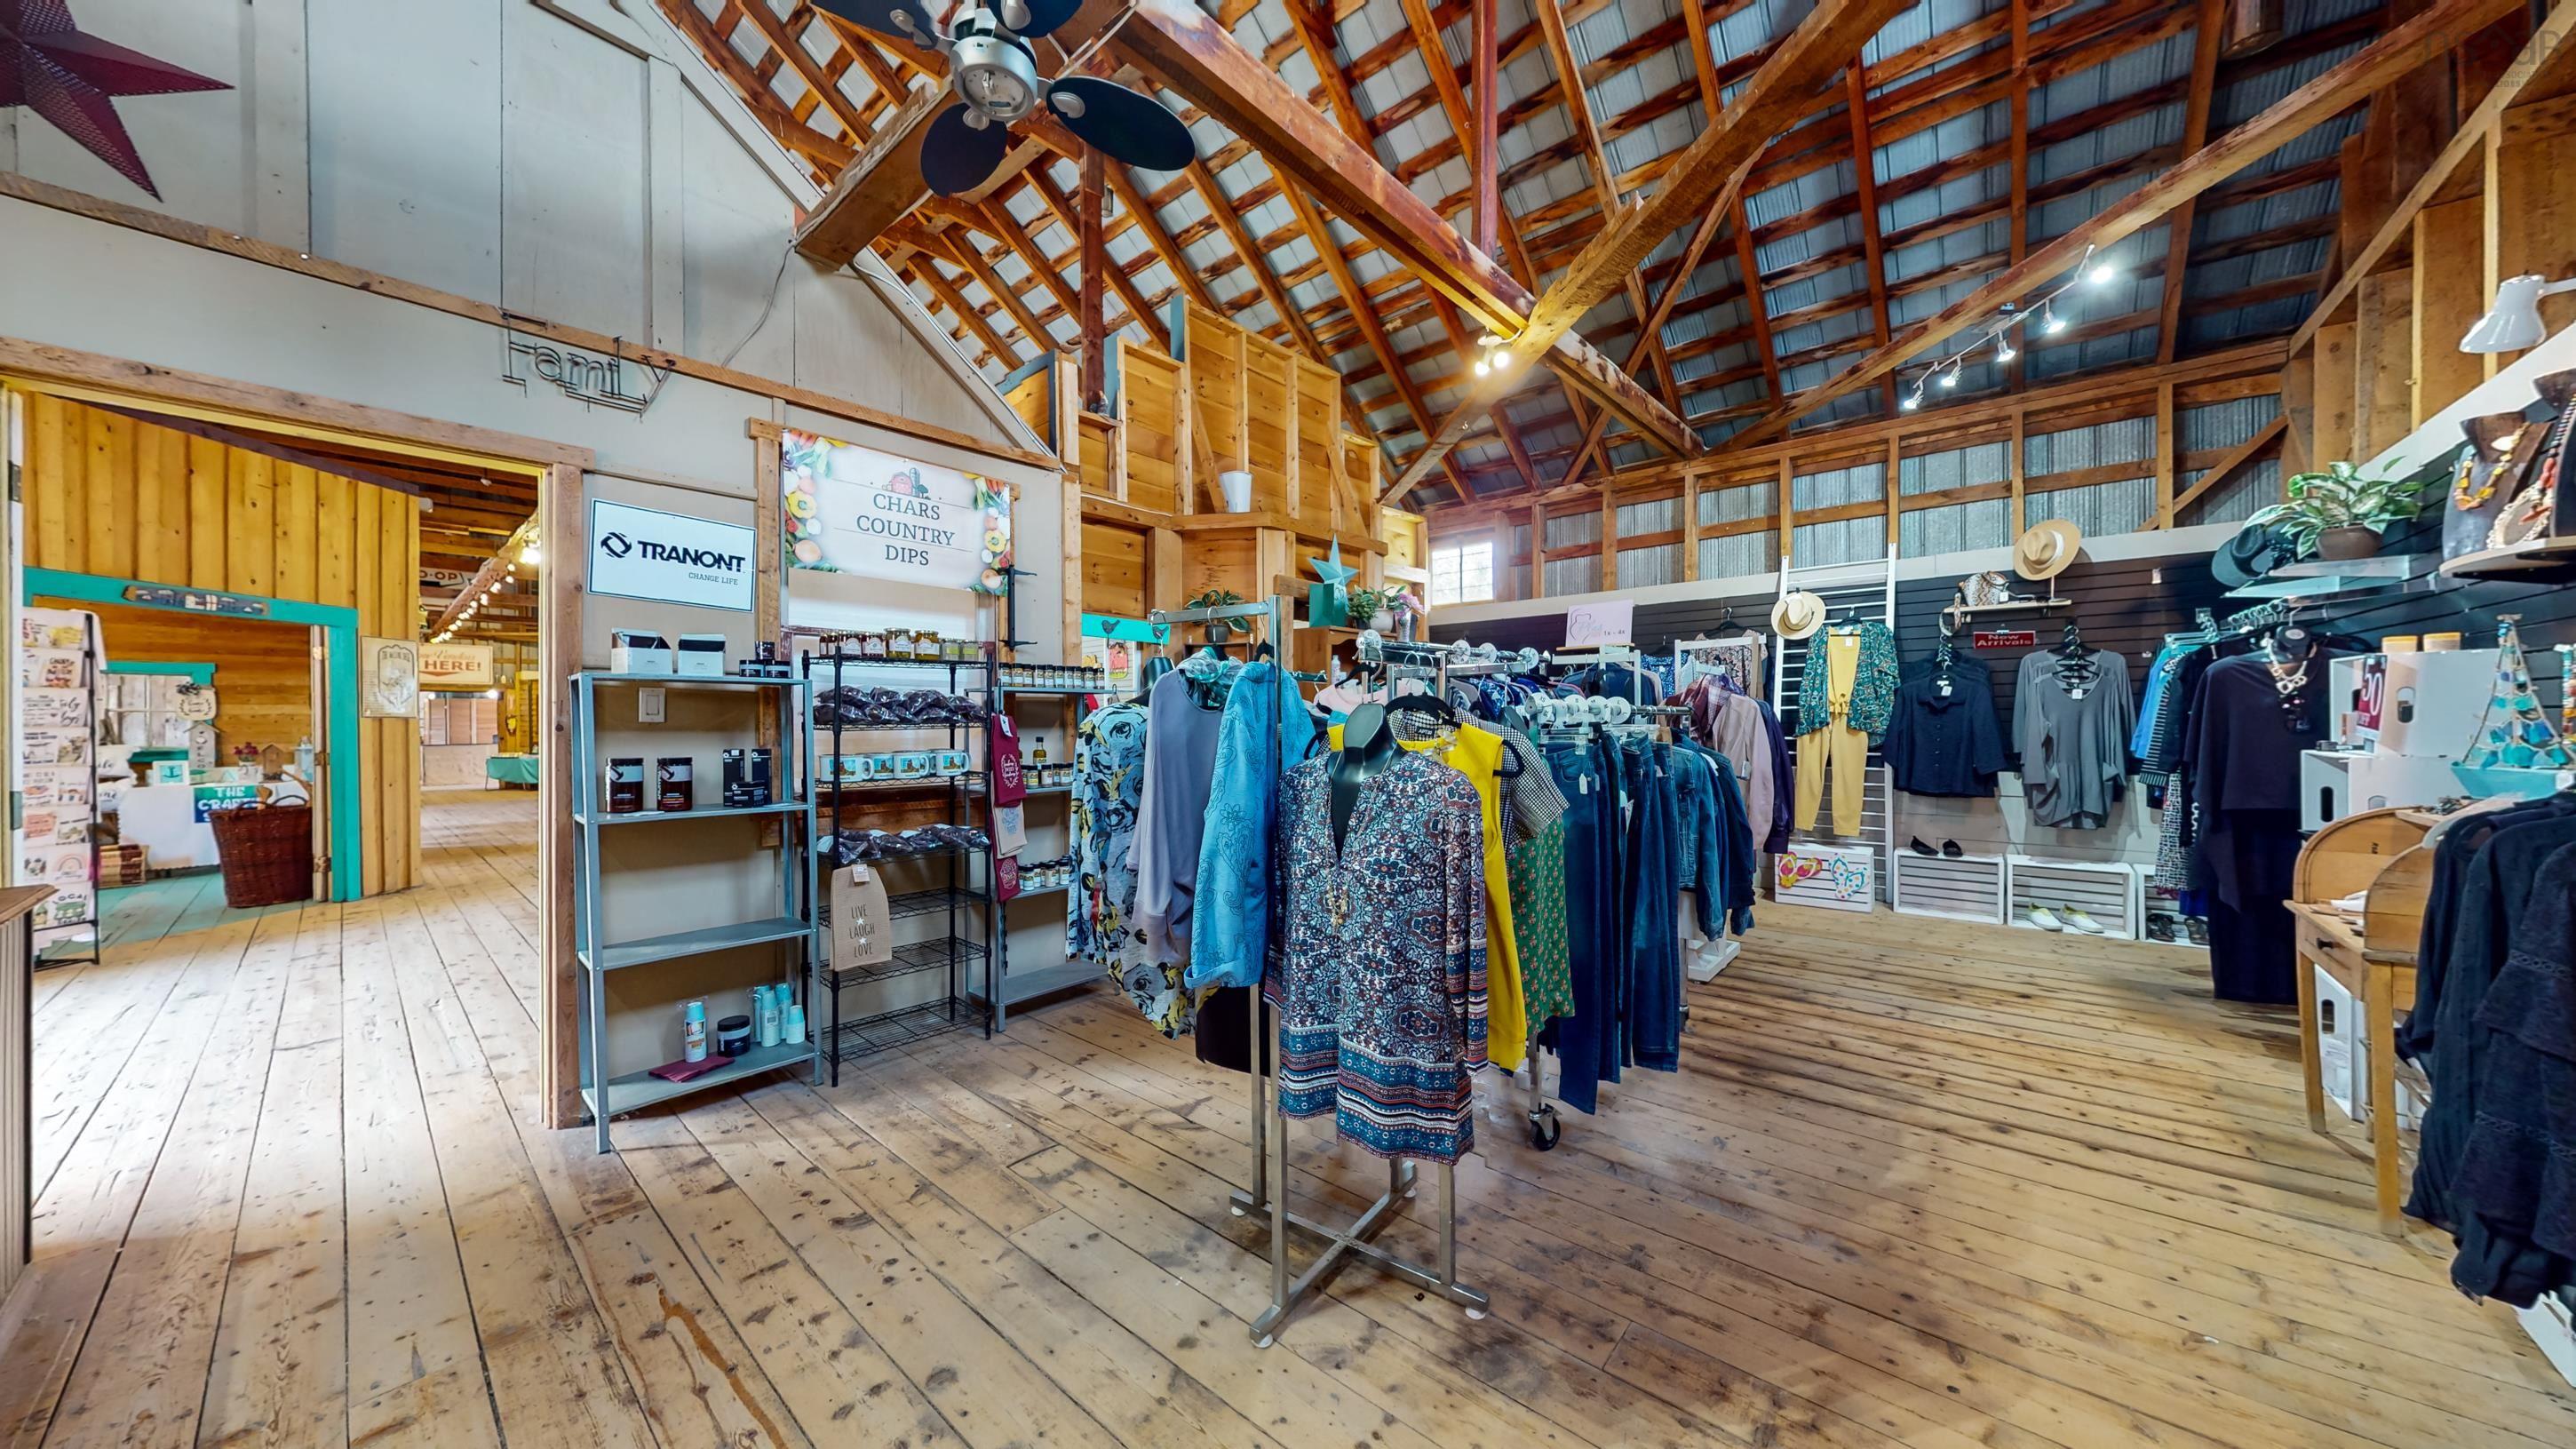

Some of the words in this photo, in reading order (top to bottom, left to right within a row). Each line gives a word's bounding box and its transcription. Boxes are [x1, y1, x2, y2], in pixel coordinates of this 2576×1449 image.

[873, 493, 940, 520] CHARS
[856, 515, 955, 545] COUNTRY
[637, 540, 745, 573] TRANONT
[885, 544, 929, 566] DIPS
[688, 572, 720, 583] CHANGE
[721, 577, 738, 585] LIFE
[424, 660, 481, 672] HERE!
[214, 786, 245, 798] THE
[851, 904, 867, 919] LIVE
[849, 923, 875, 940] LAUGH
[854, 943, 872, 958] LOVE
